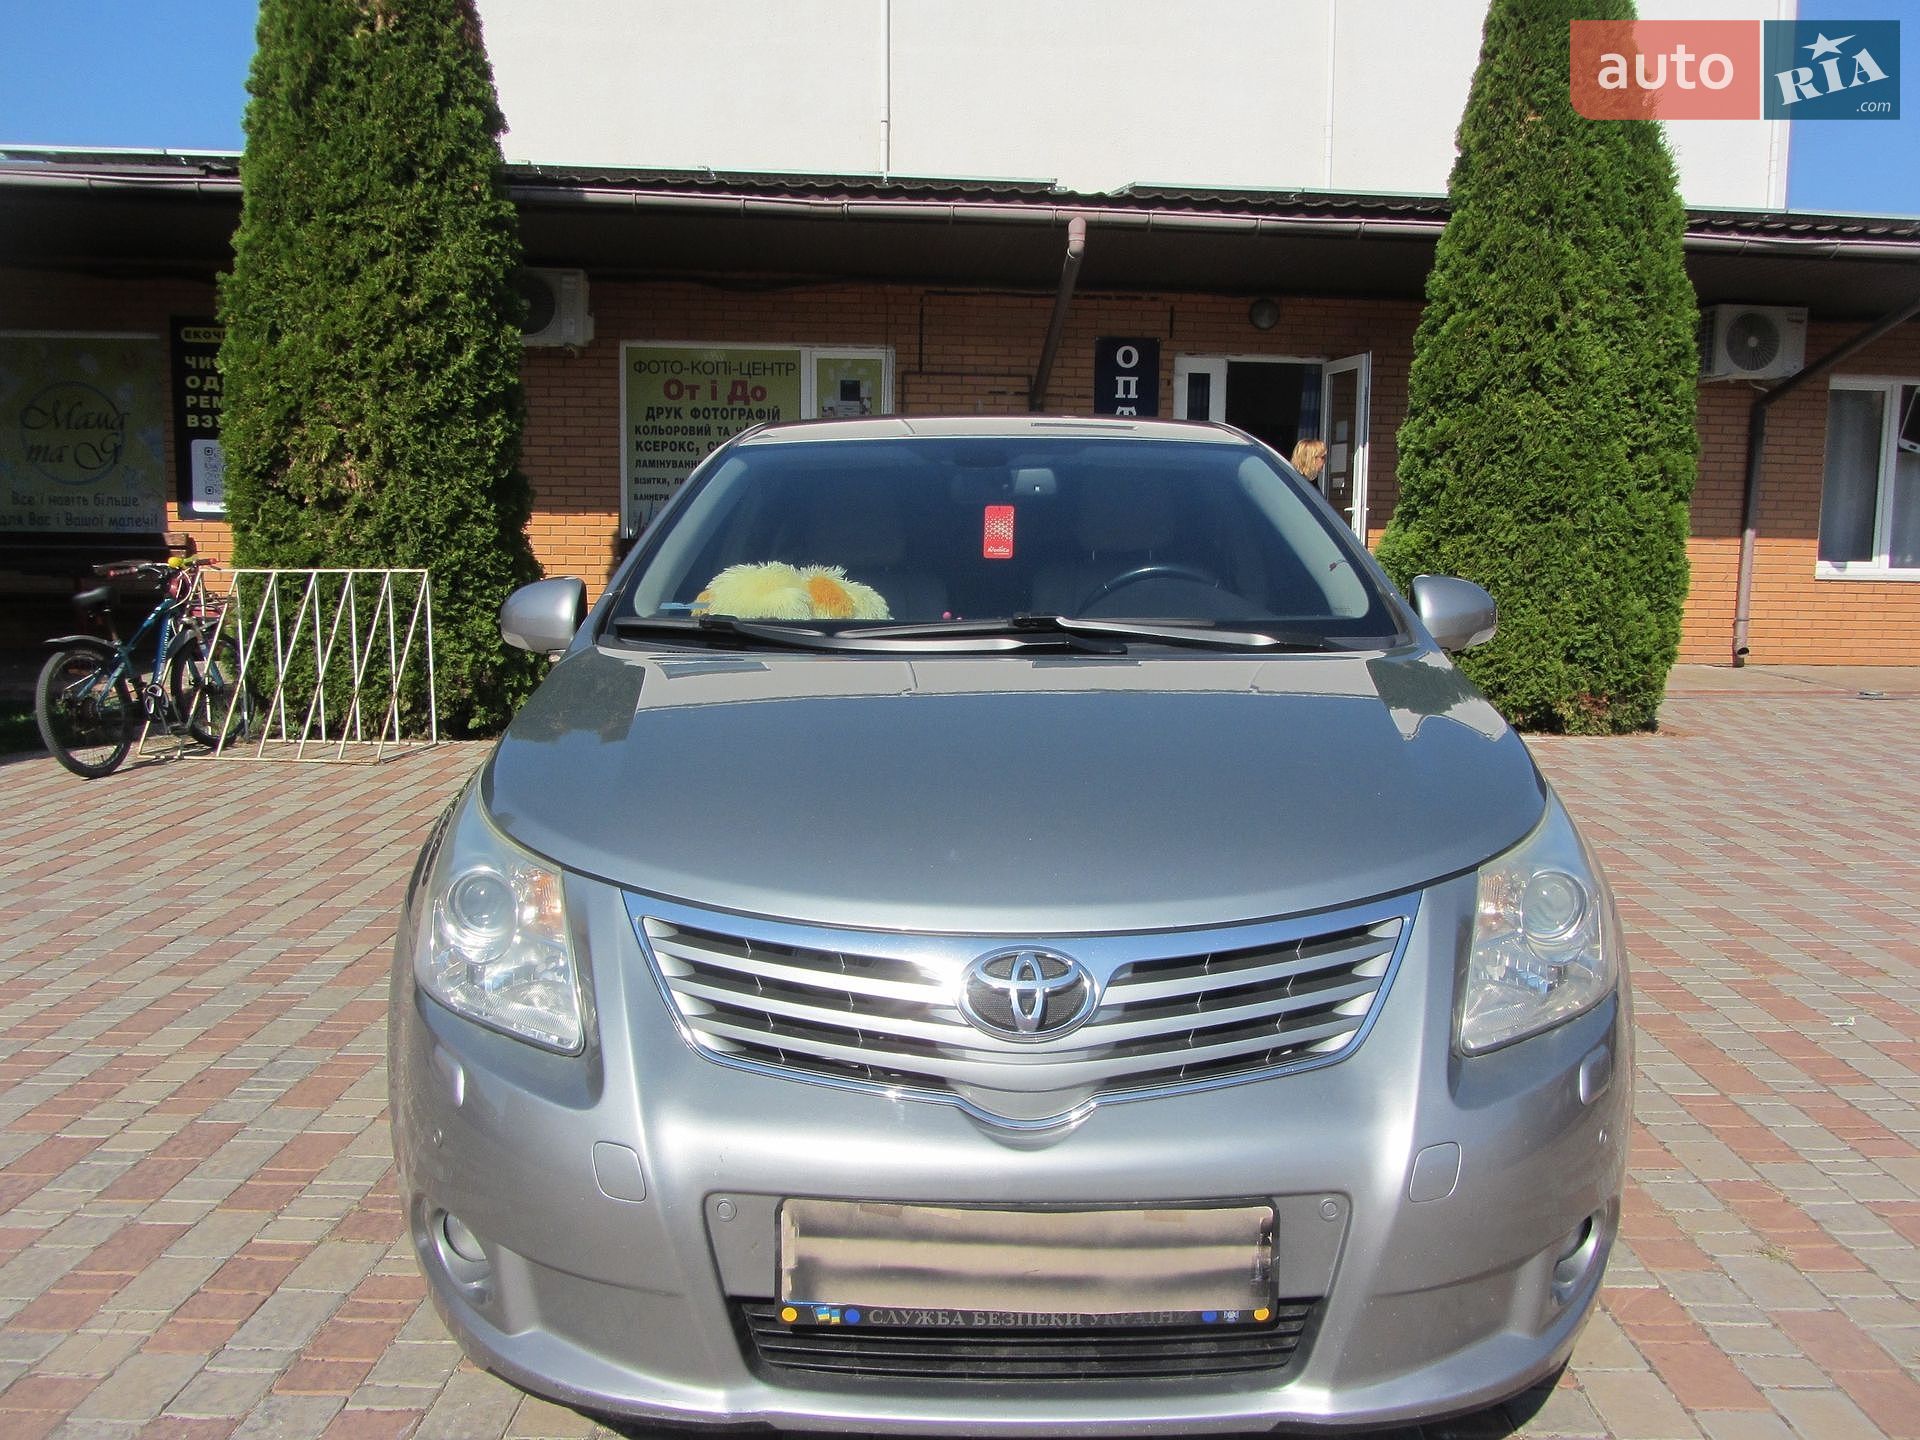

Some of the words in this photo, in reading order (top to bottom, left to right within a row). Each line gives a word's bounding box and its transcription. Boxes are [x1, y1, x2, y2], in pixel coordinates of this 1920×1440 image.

[663, 378, 700, 401] От
[727, 379, 768, 405] До
[645, 406, 683, 422] ДРУК
[690, 406, 781, 421] ФОТОГРАФІЙ
[635, 424, 711, 437] КОЛЬОРОВИЙ
[717, 426, 730, 436] ТА
[636, 441, 700, 456] КСЕРОКС,
[868, 1308, 966, 1327] СЛУЖБА
[971, 1310, 1082, 1327] БЕЗПЕКИ
